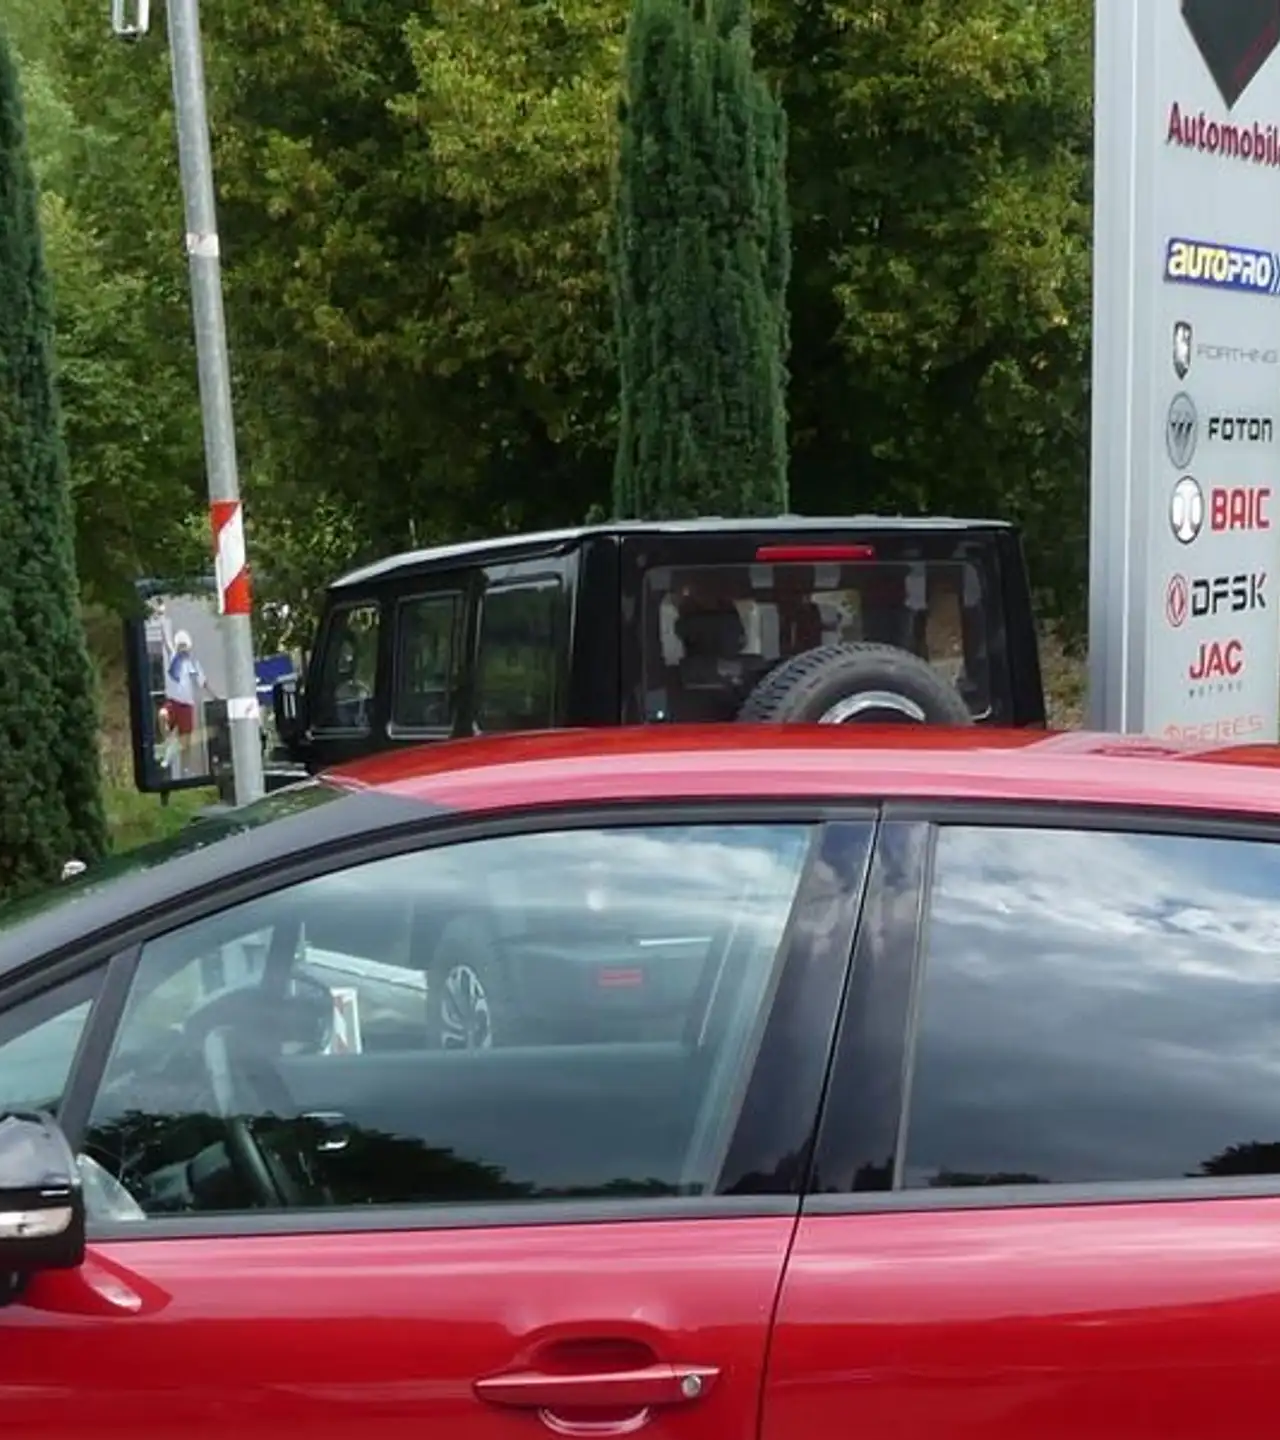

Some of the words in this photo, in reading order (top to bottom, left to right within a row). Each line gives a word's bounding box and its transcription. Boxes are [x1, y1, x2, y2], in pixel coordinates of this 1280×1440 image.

[1207, 417, 1273, 442] FOTON
[1210, 487, 1271, 532] BAIC
[1191, 572, 1267, 617] DFSK
[1189, 640, 1243, 679] JAC
